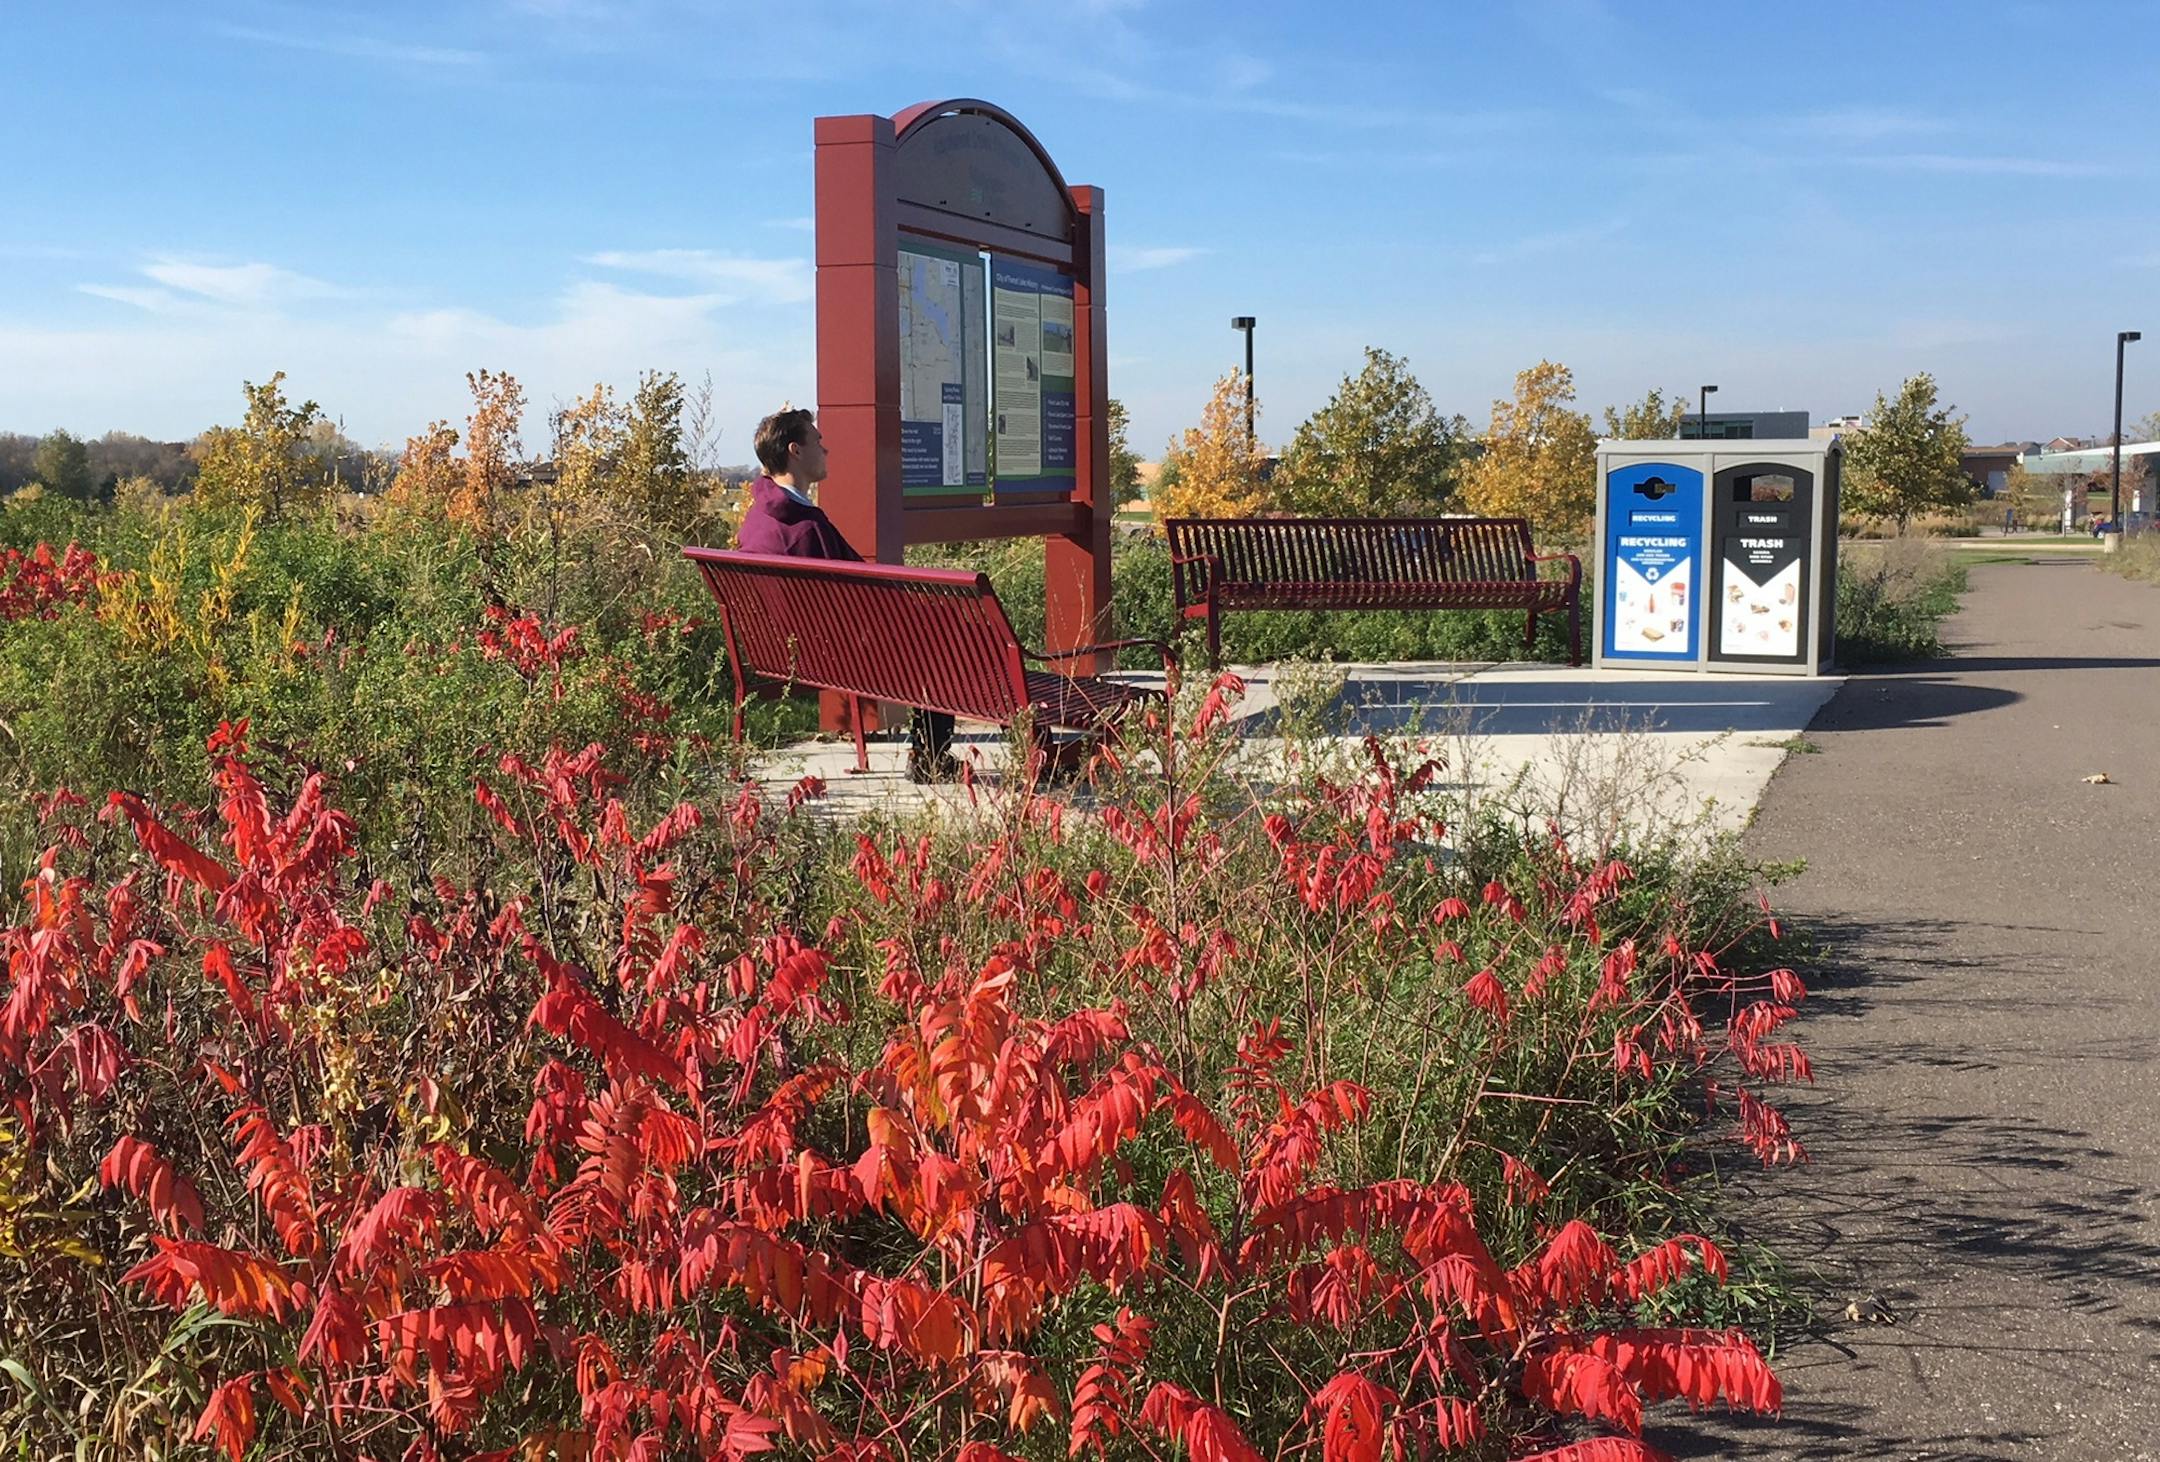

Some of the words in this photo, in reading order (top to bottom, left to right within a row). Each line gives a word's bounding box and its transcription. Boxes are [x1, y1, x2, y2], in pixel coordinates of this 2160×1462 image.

[1632, 515, 1676, 523] RECYCLING
[1621, 537, 1687, 548] RECYCLING
[1740, 539, 1784, 548] TRASH
